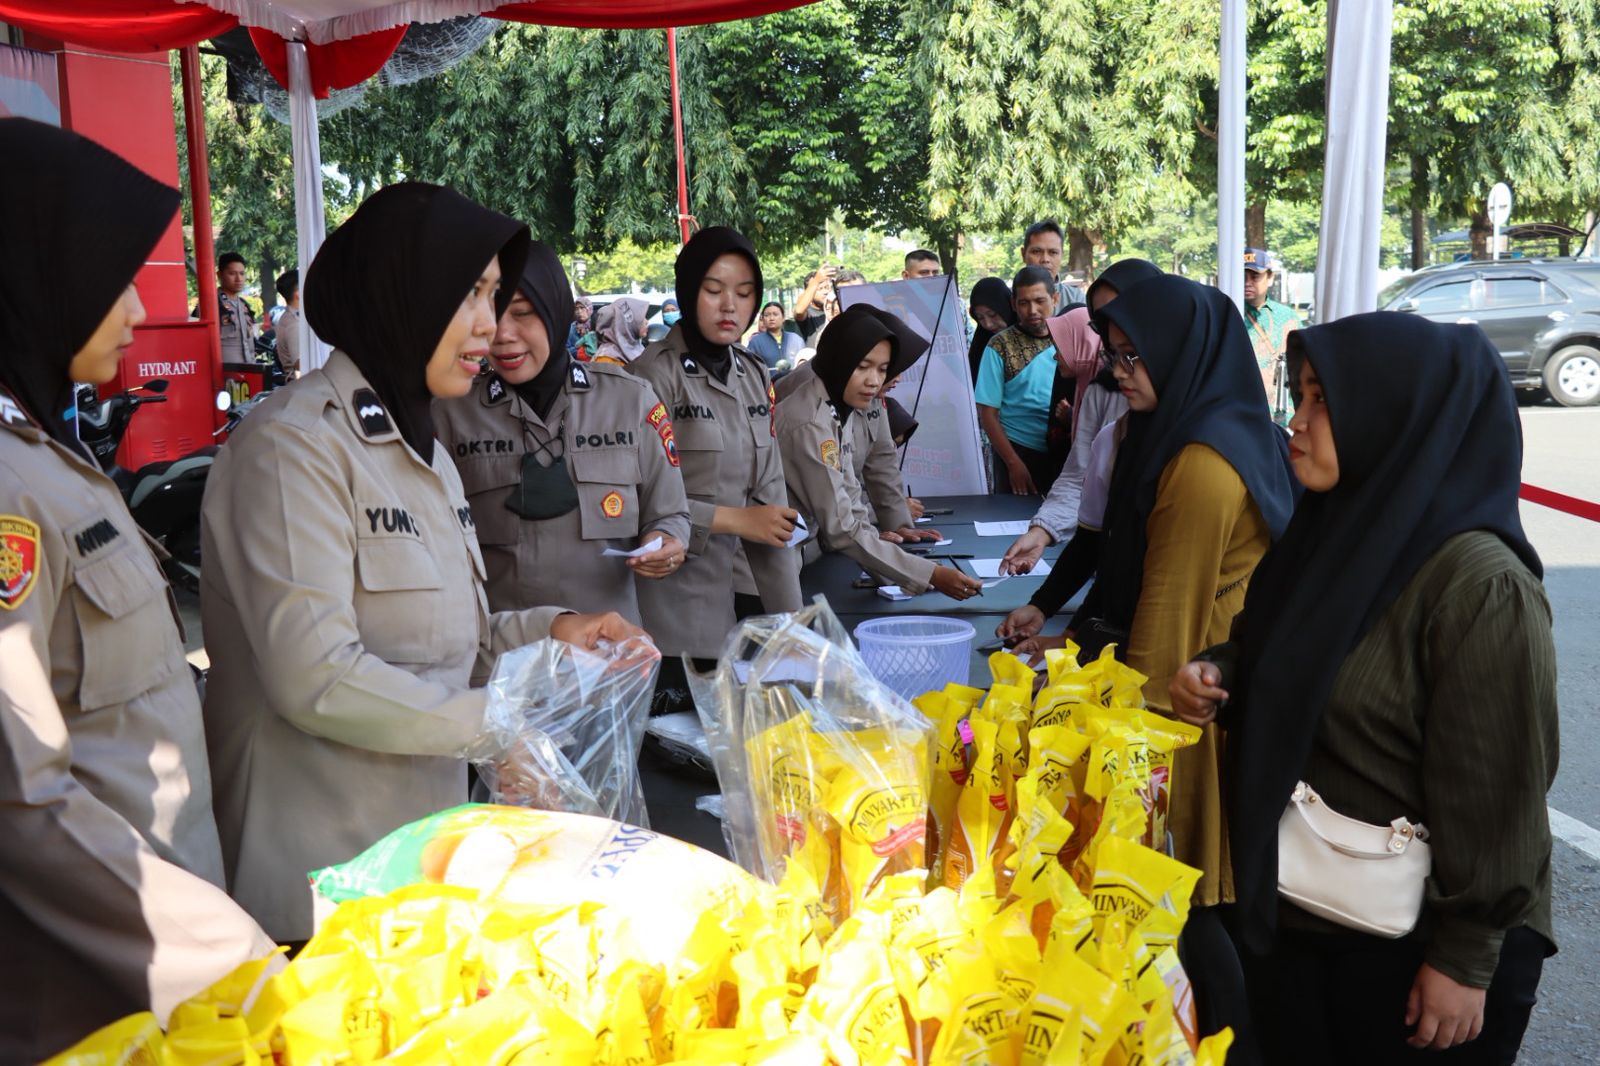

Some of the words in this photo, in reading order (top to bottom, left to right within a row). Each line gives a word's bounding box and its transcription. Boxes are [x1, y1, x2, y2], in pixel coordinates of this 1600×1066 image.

[138, 361, 196, 377] HYDRANT
[674, 404, 715, 420] KAYLA
[576, 431, 634, 448] POLRI
[457, 439, 514, 457] OKTRI
